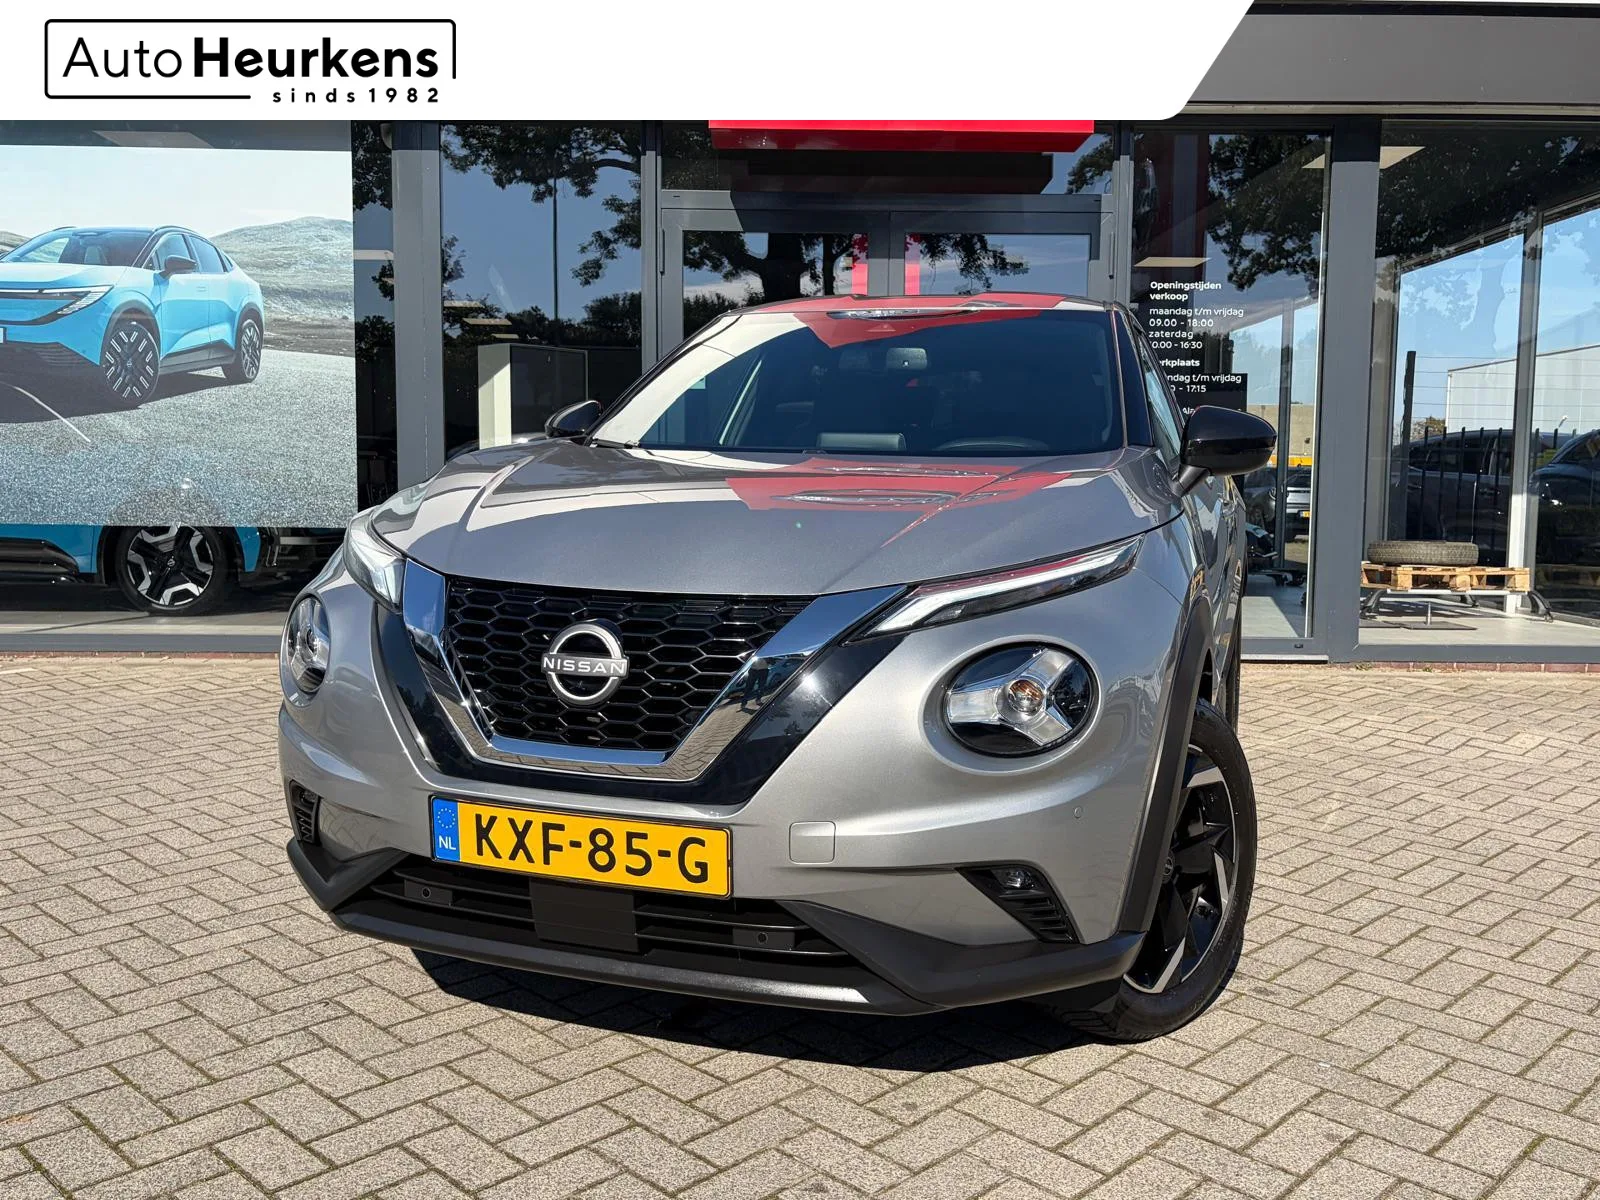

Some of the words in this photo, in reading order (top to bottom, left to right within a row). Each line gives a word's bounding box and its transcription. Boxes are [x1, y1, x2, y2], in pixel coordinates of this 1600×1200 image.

[1150, 281, 1222, 291] Openingstijden
[1149, 292, 1189, 301] verkoop
[1149, 307, 1193, 317] maandag
[1194, 307, 1212, 316] t/m
[1213, 307, 1244, 318] vrijdag
[1187, 318, 1214, 327] 18:00
[1148, 329, 1194, 340] zaterdag
[1149, 341, 1172, 349] 0.00
[1160, 358, 1200, 368] rkplaats
[1167, 374, 1191, 383] ndag
[1192, 374, 1210, 382] t/m
[1211, 374, 1242, 383] vrijdag
[543, 655, 626, 675] NISSAN
[438, 836, 457, 851] NL
[474, 813, 709, 884] KXF-85-G
